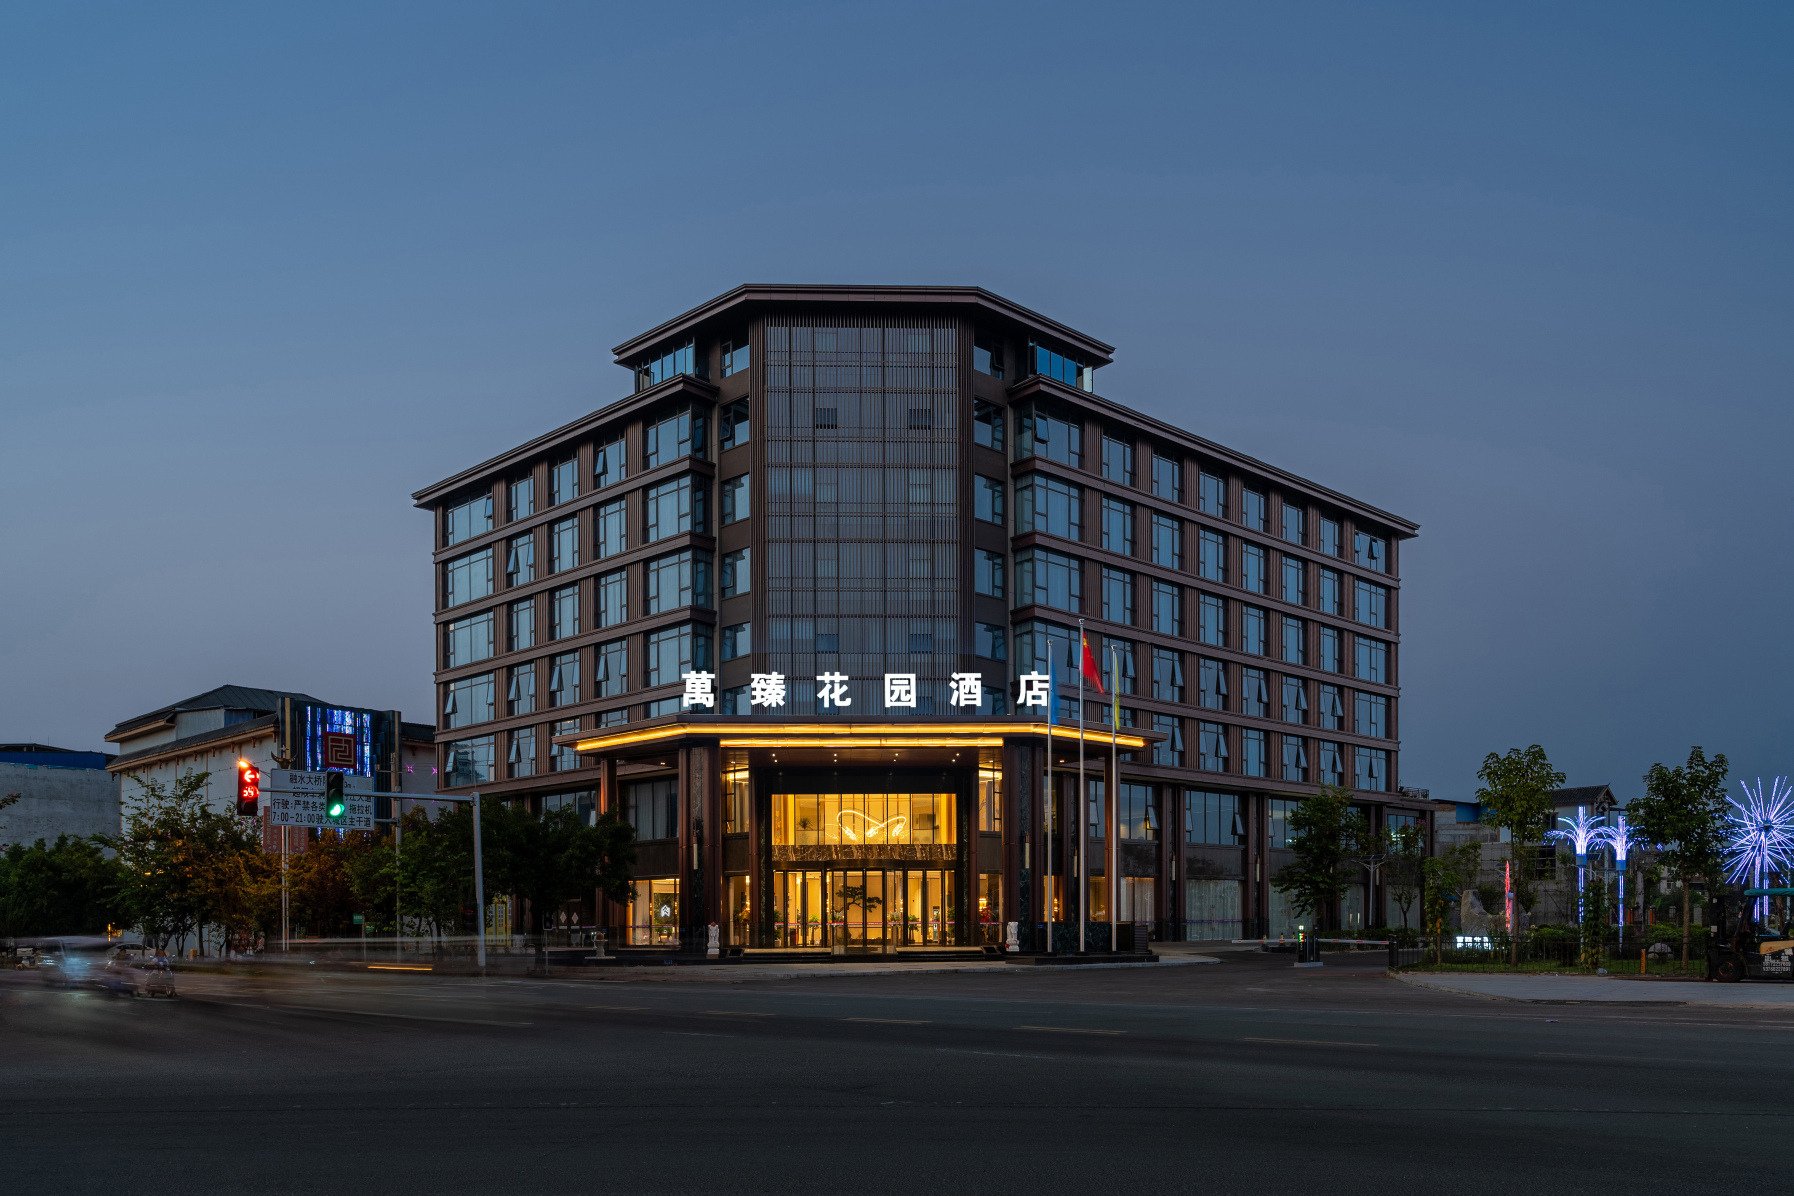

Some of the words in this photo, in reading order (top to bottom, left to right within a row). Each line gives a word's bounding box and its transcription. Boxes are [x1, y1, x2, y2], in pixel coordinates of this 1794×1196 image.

[682, 670, 1050, 707] 萬臻花园酒店
